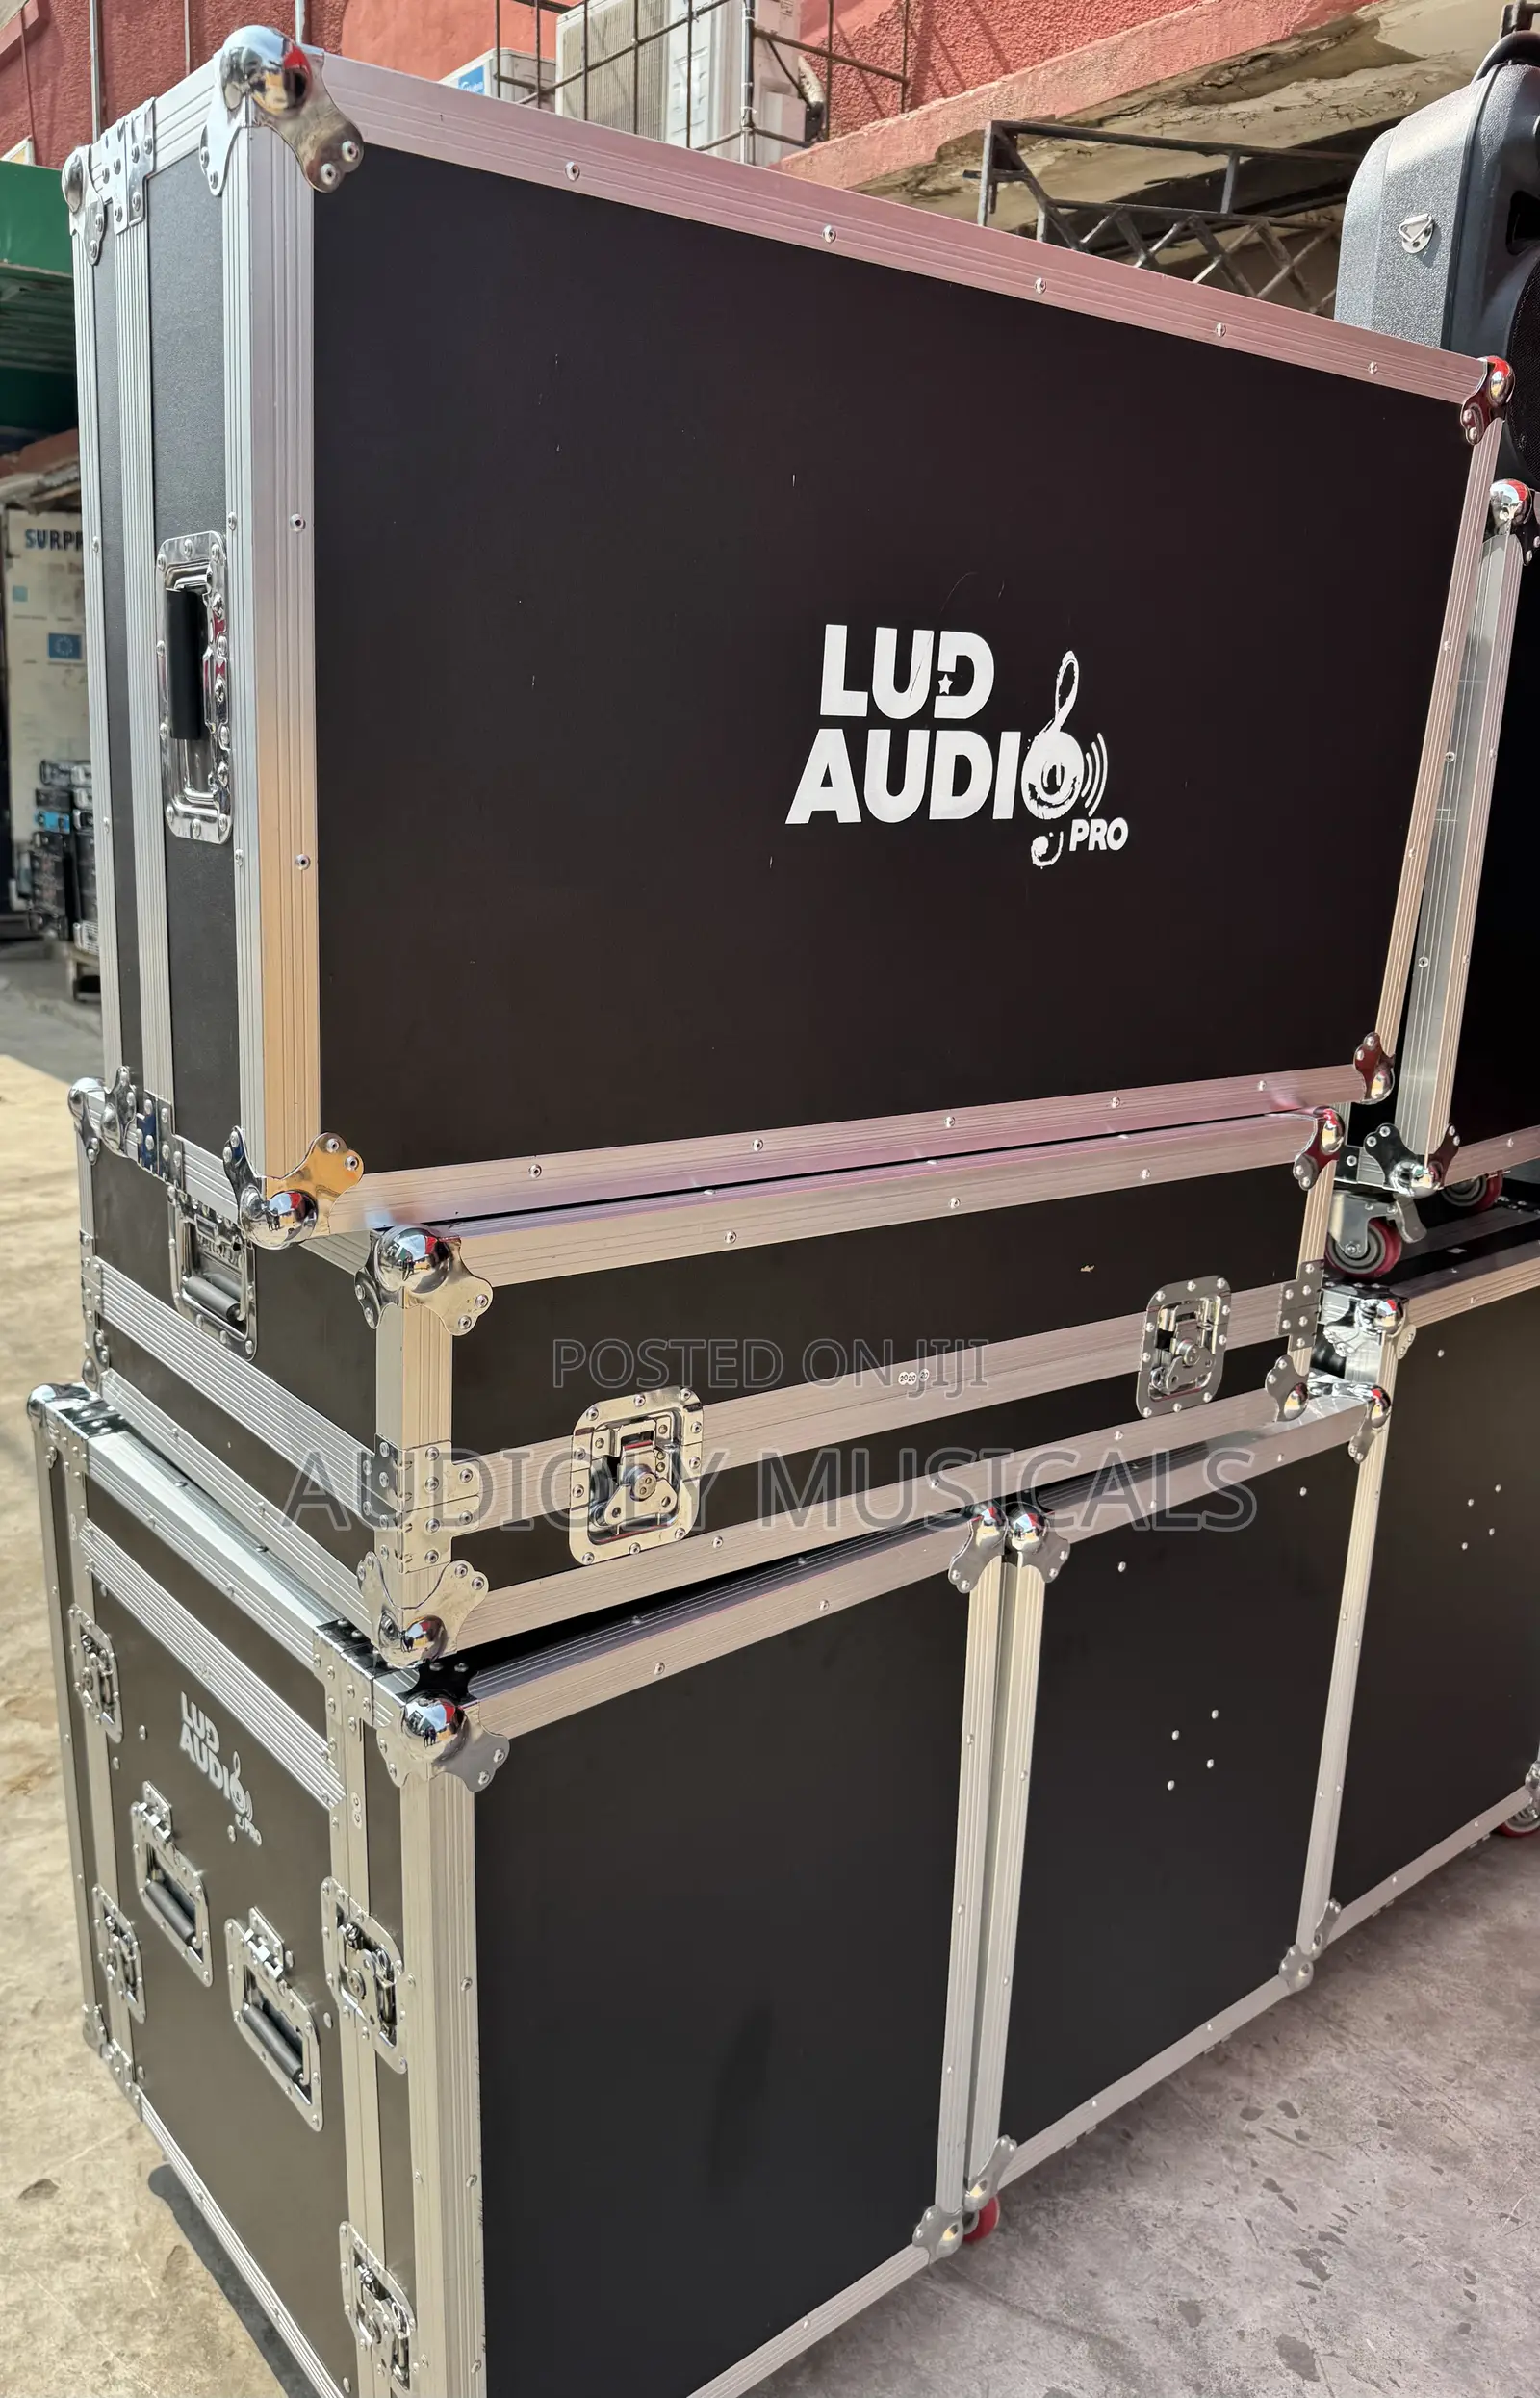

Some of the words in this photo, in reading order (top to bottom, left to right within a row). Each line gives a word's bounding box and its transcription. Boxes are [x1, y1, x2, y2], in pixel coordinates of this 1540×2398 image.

[820, 624, 995, 720] LUD
[785, 728, 1085, 824] AUDIO
[1069, 817, 1129, 851] PRO
[179, 1722, 246, 1814] AUDIO
[181, 1690, 220, 1754] LUD
